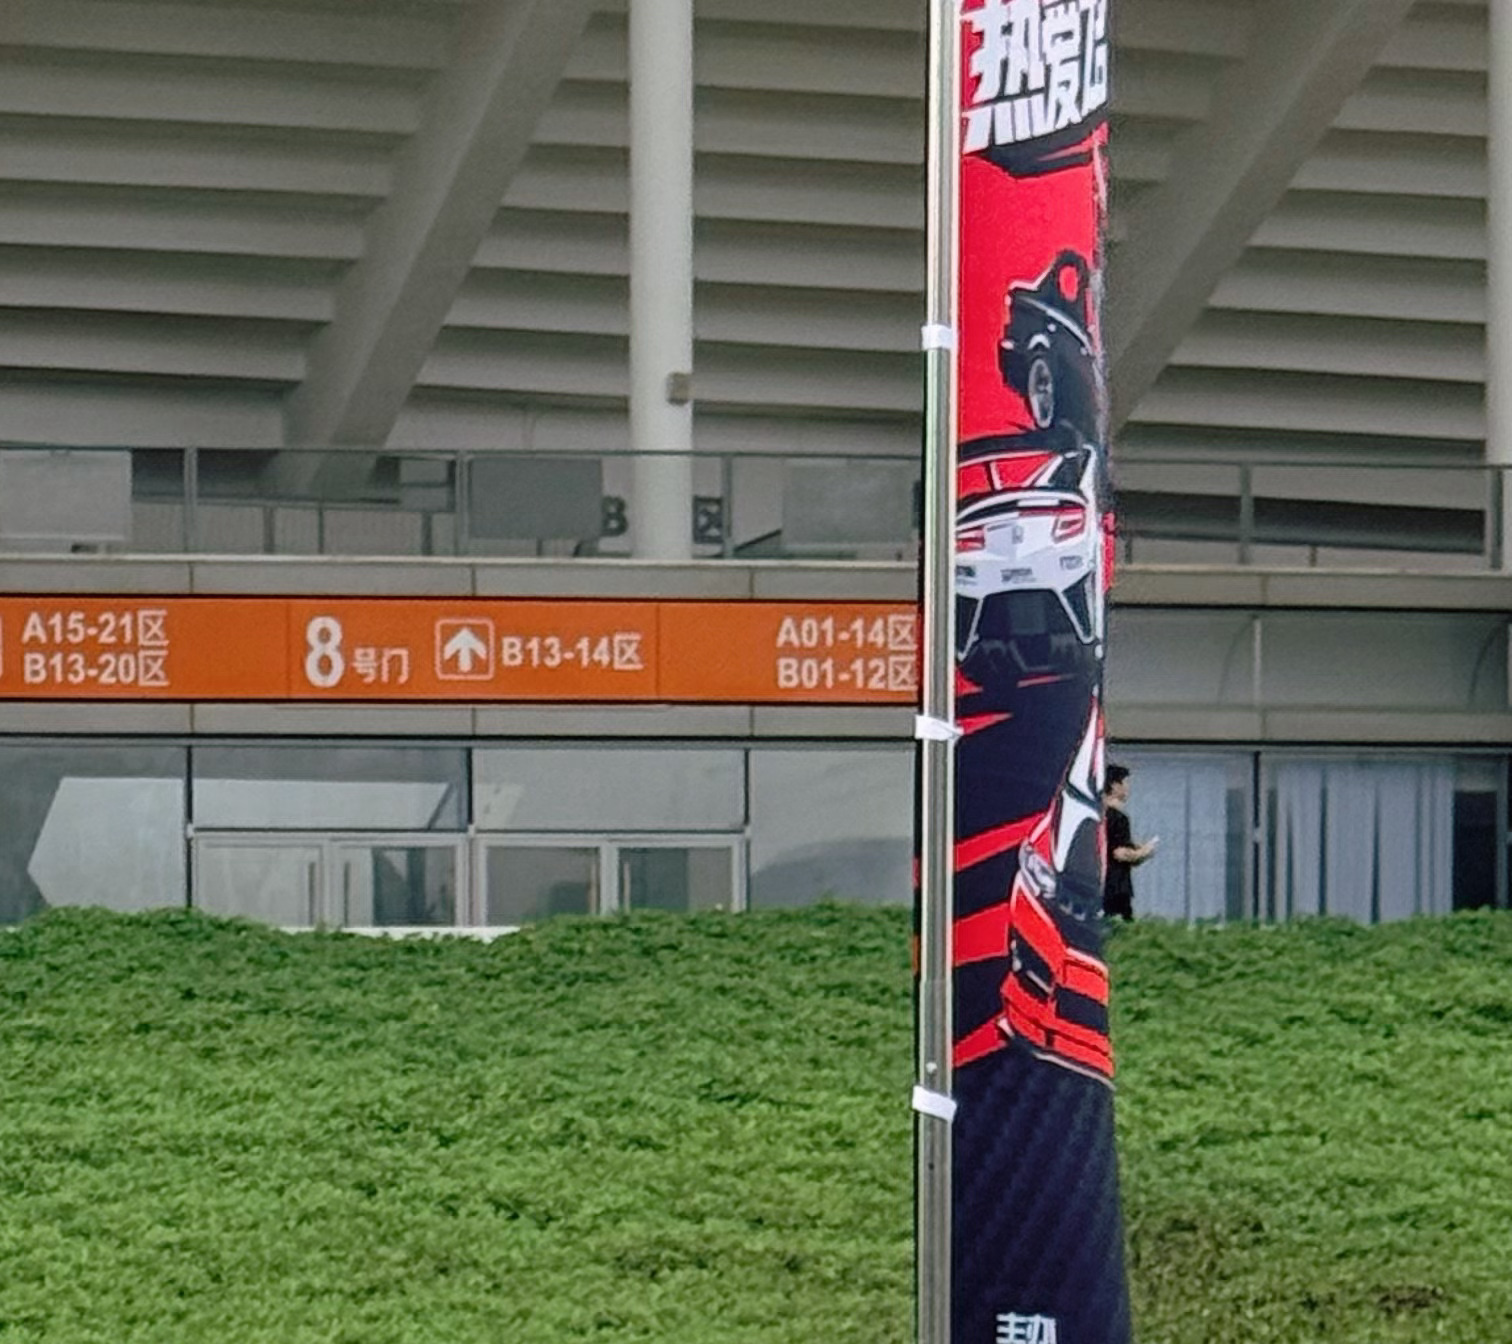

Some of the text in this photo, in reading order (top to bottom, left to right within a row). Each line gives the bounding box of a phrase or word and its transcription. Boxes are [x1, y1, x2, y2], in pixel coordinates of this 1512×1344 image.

[22, 610, 169, 646] A15-21区
[776, 614, 917, 650] A01-14区
[23, 650, 170, 686] B13-20区
[305, 615, 410, 687] 8号门
[501, 632, 644, 670] B13-14区
[777, 653, 918, 691] B01-12区
